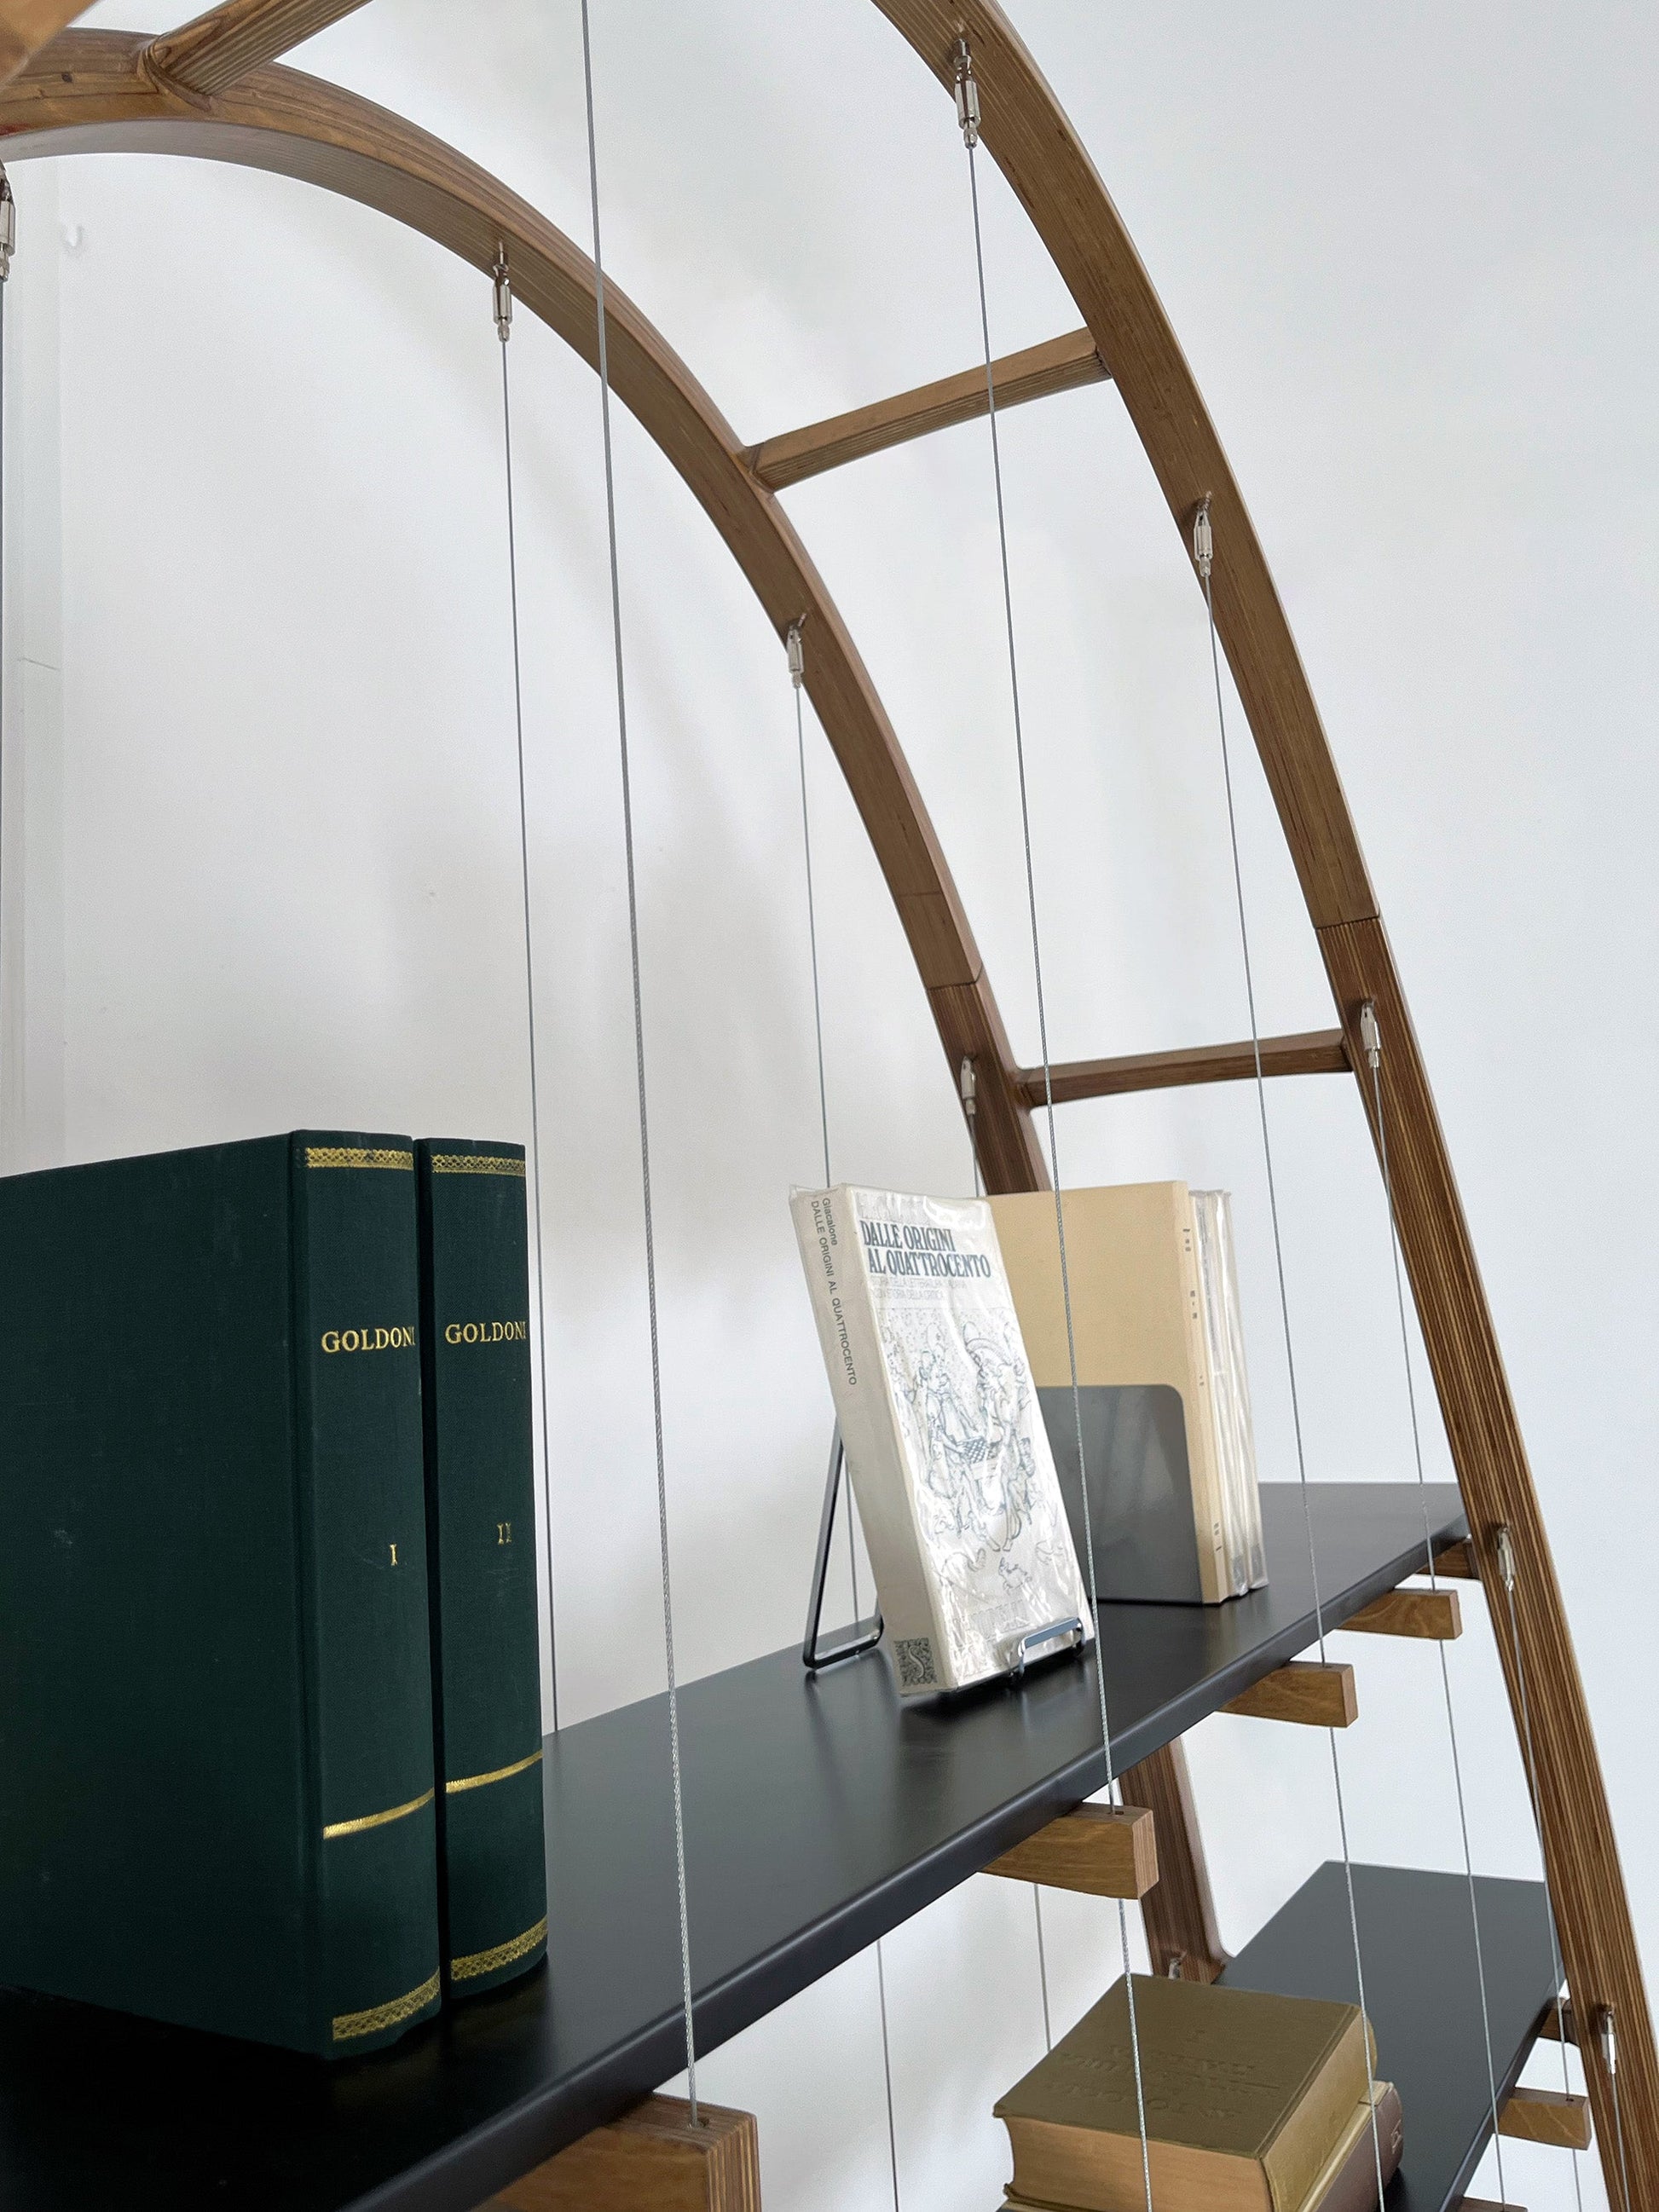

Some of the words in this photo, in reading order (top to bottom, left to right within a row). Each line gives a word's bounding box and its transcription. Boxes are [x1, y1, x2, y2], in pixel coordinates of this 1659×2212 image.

[811, 1200, 826, 1234] DALLE
[822, 1197, 838, 1245] Giacalone
[859, 1220, 903, 1249] DALLE
[903, 1225, 957, 1253] ORIGINI
[818, 1237, 835, 1277] ORIGINI
[867, 1248, 887, 1275] AL
[886, 1250, 991, 1279] QUATTROCENTO
[828, 1280, 838, 1295] AL
[321, 1325, 416, 1354] GOLDONI
[444, 1320, 527, 1344] GOLDONI
[831, 1297, 858, 1385] QUATTROCENTO
[496, 1522, 512, 1545] II
[389, 1543, 398, 1566] I
